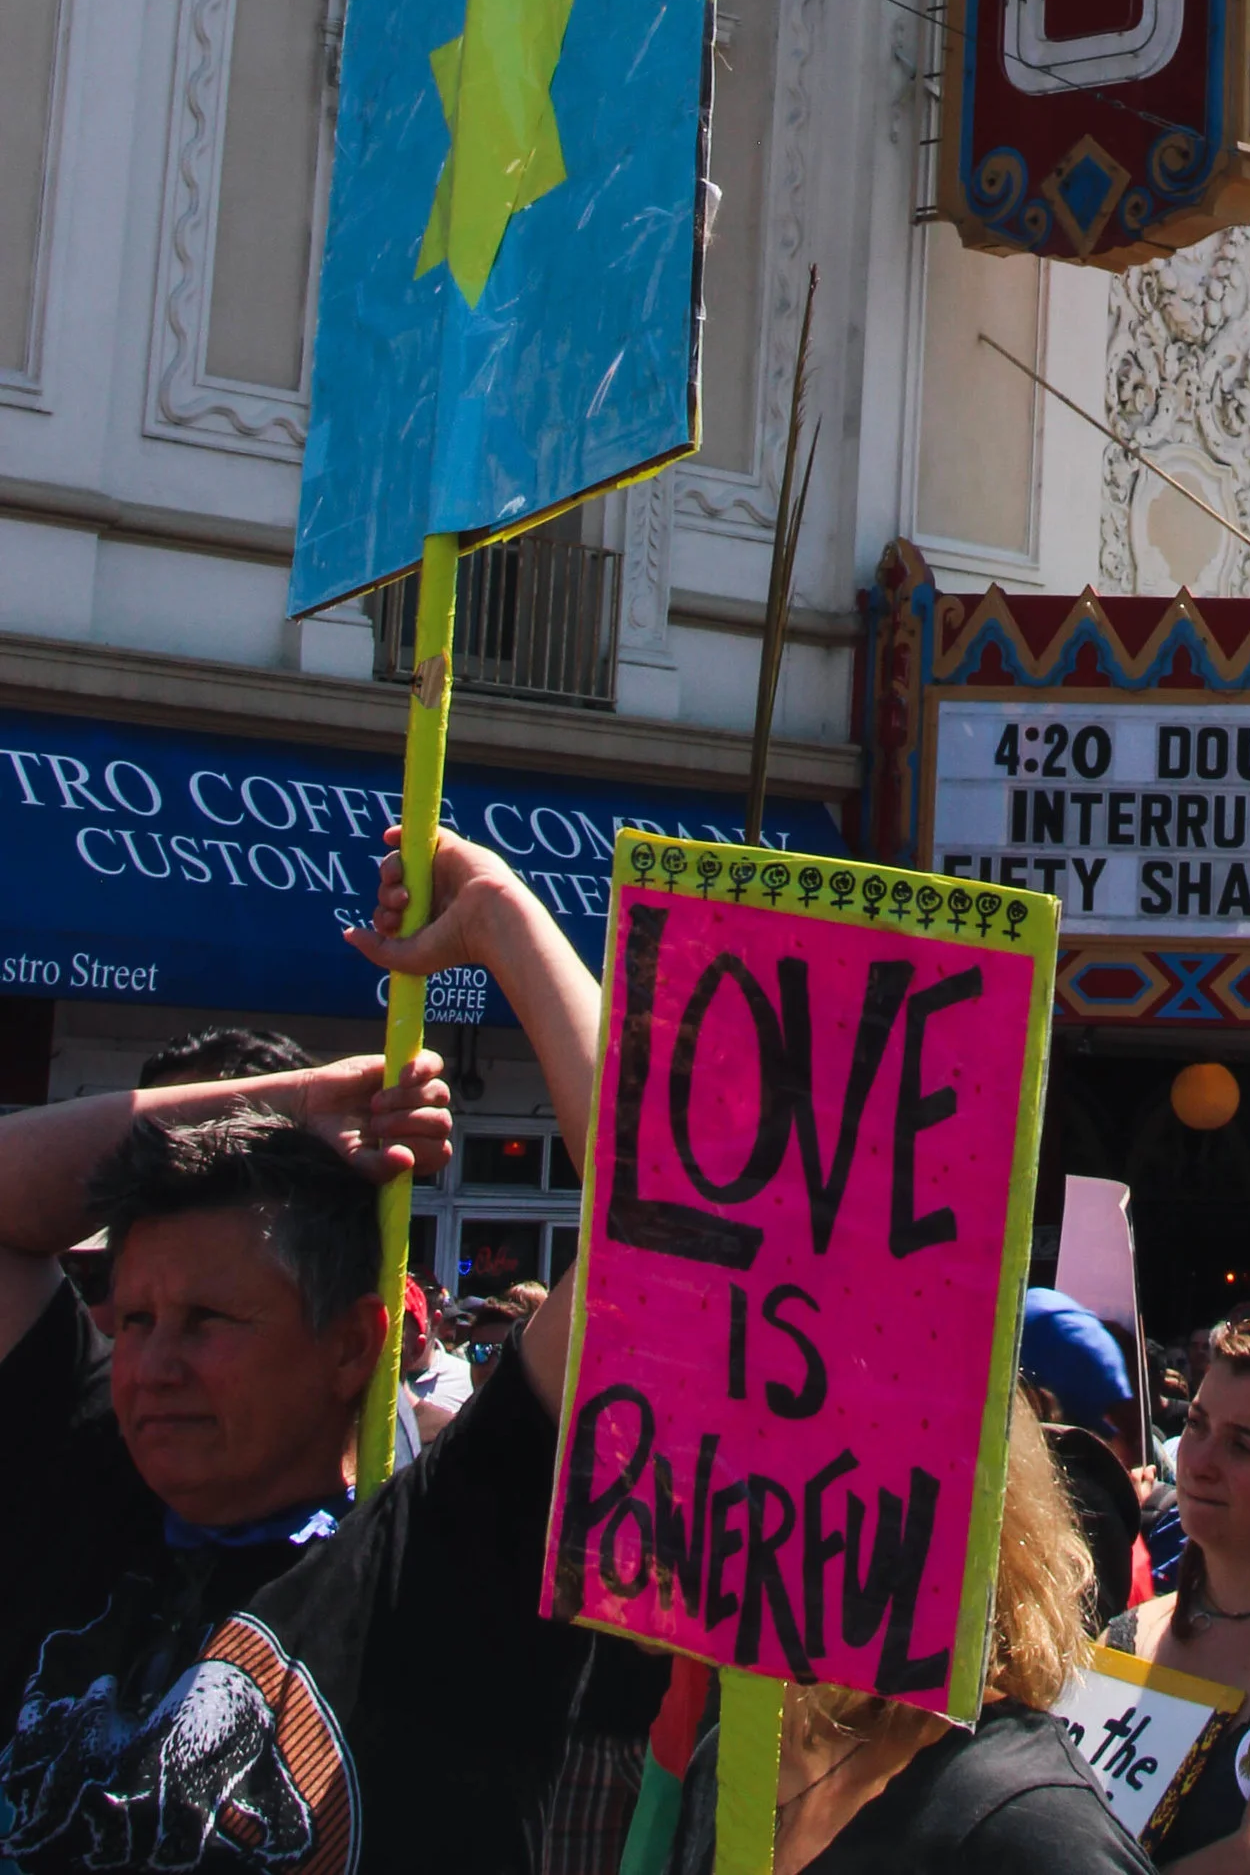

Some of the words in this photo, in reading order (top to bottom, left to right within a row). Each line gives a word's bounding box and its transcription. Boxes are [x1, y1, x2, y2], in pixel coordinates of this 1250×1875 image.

[994, 724, 1112, 779] 4:20
[76, 826, 361, 897] CUSTOM
[70, 952, 160, 992] Street
[425, 967, 488, 988] ASTRO
[424, 1007, 485, 1025] OMPANY
[605, 902, 985, 1272] LOVE
[728, 1283, 827, 1421] IS
[551, 1383, 951, 1696] POWERFUL
[1090, 1707, 1158, 1791] the
